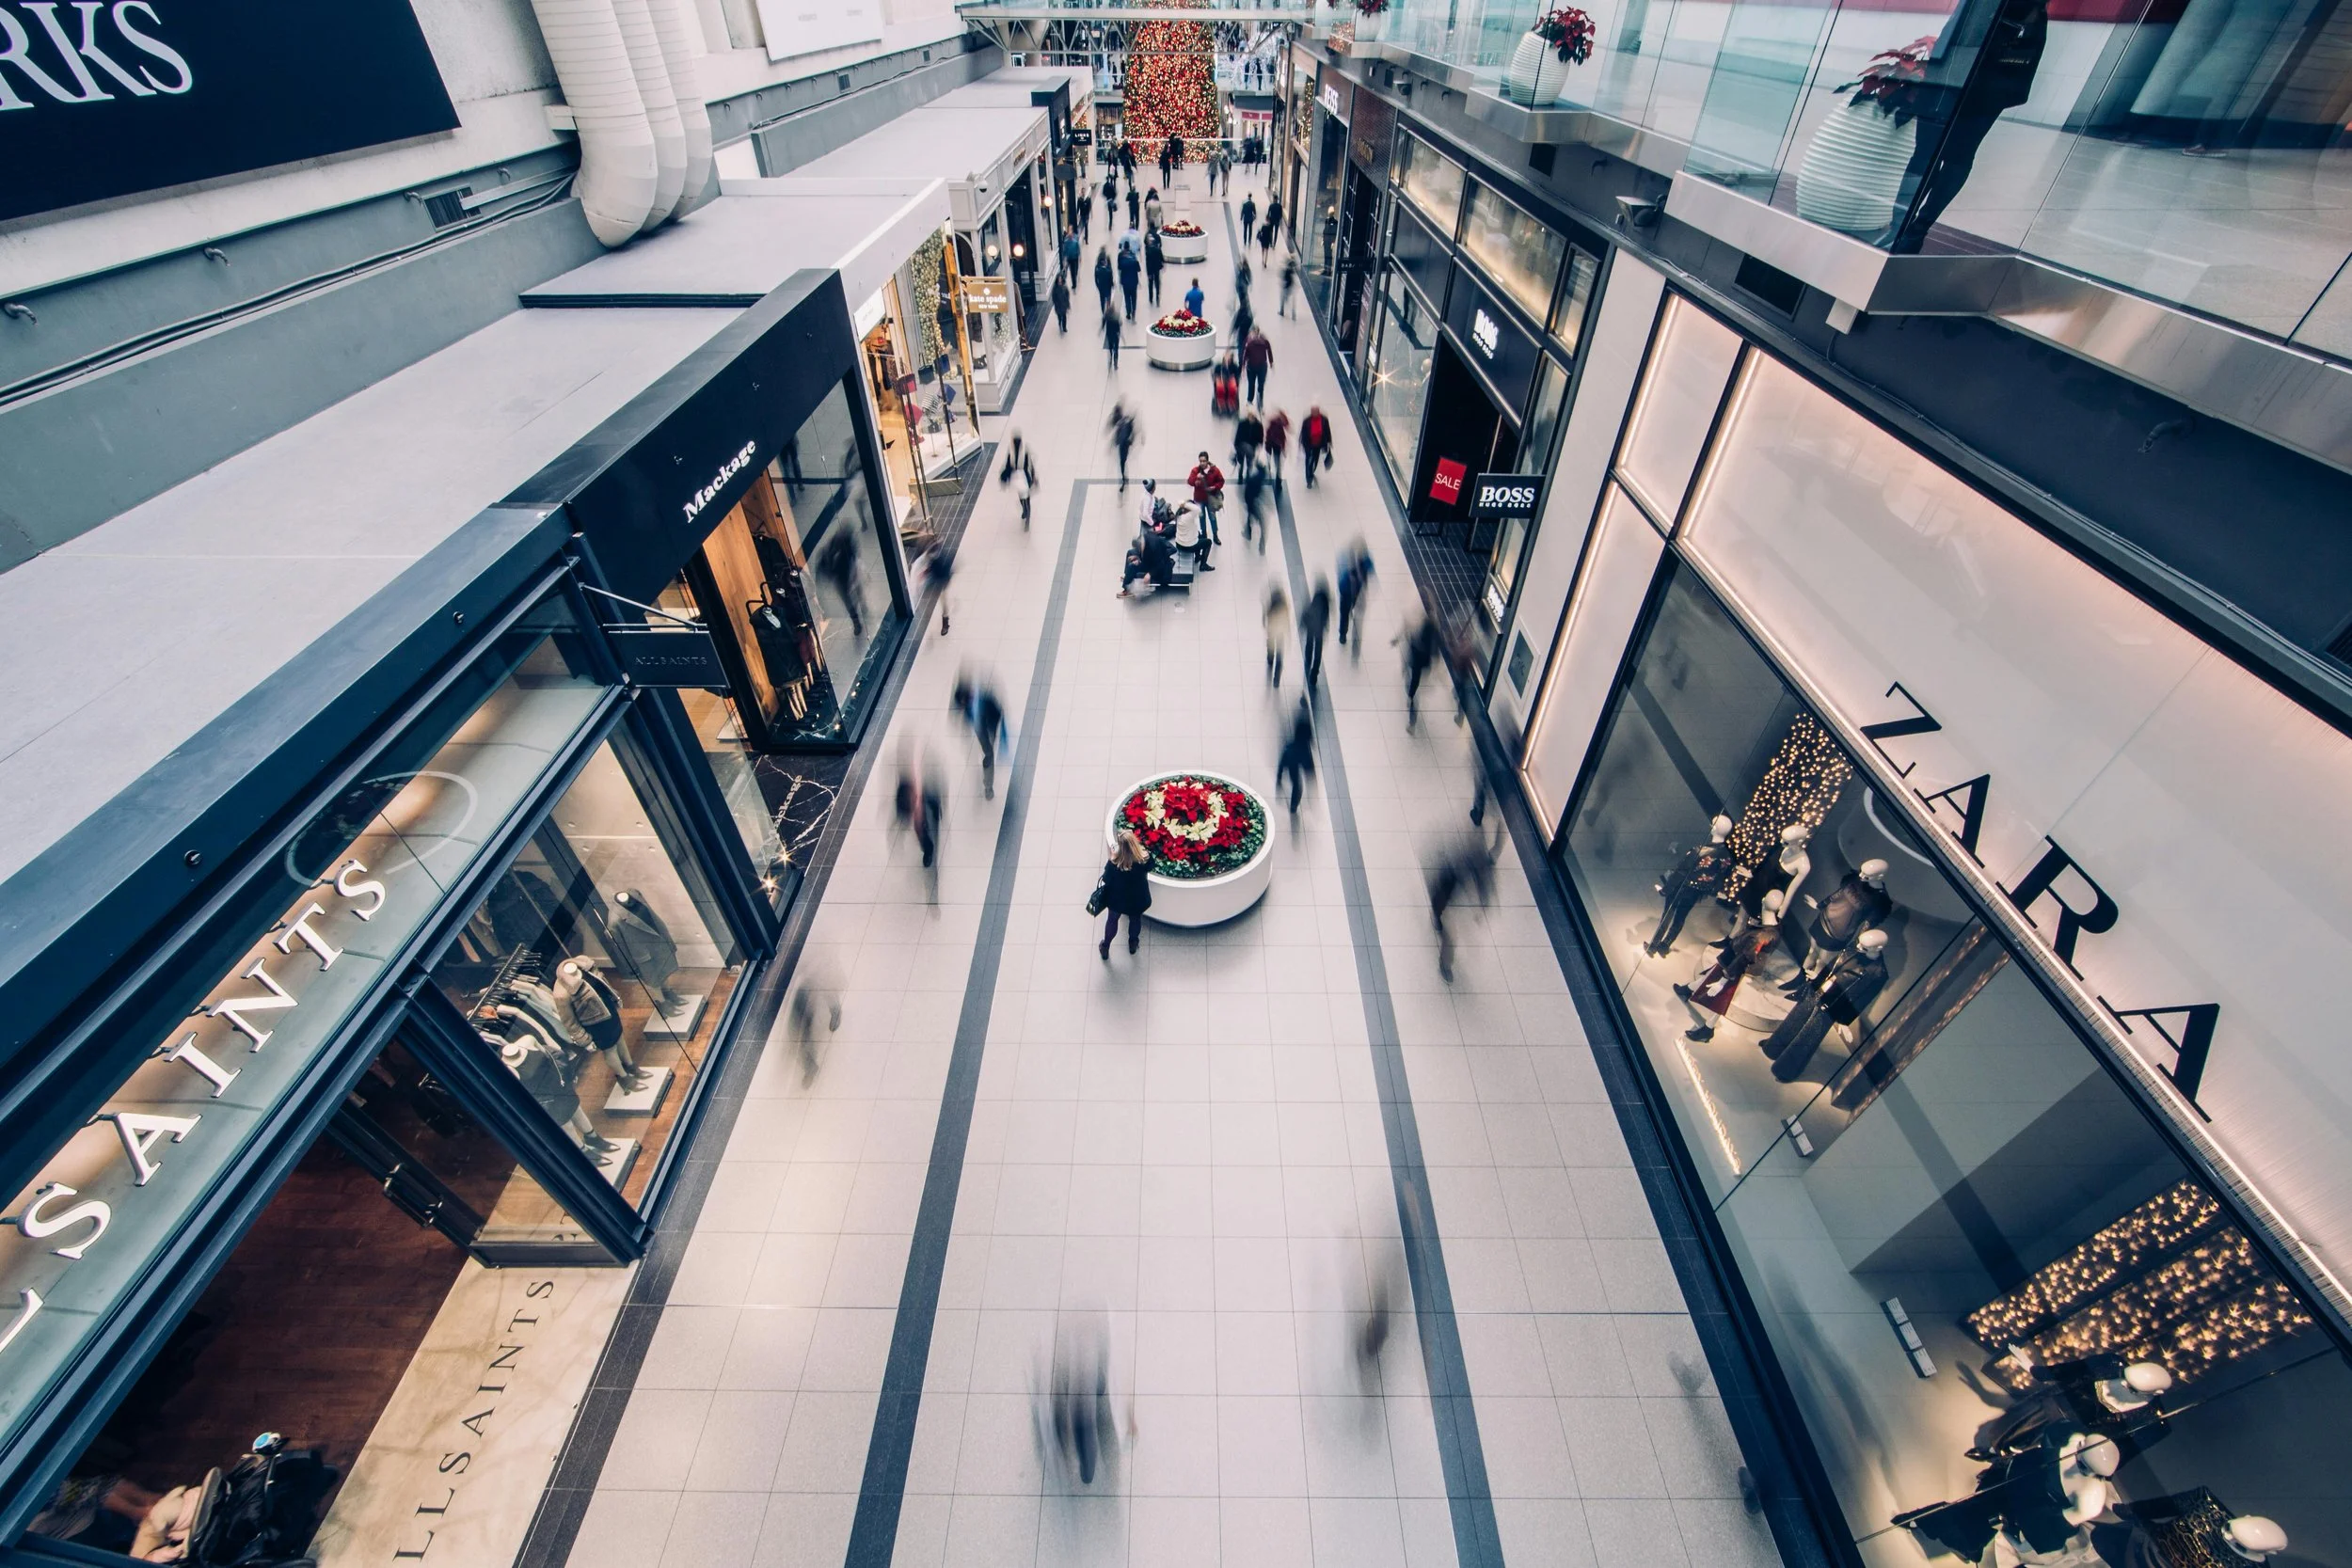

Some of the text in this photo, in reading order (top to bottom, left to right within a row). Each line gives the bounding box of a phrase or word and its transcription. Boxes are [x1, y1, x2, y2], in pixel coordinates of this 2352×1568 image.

[969, 294, 1007, 305] kate spade
[682, 440, 756, 524] Mackage
[1434, 472, 1462, 491] SALE
[1479, 486, 1535, 503] BOSS
[634, 657, 707, 665] ALLSAINTS
[1860, 681, 2220, 1123] ZARA
